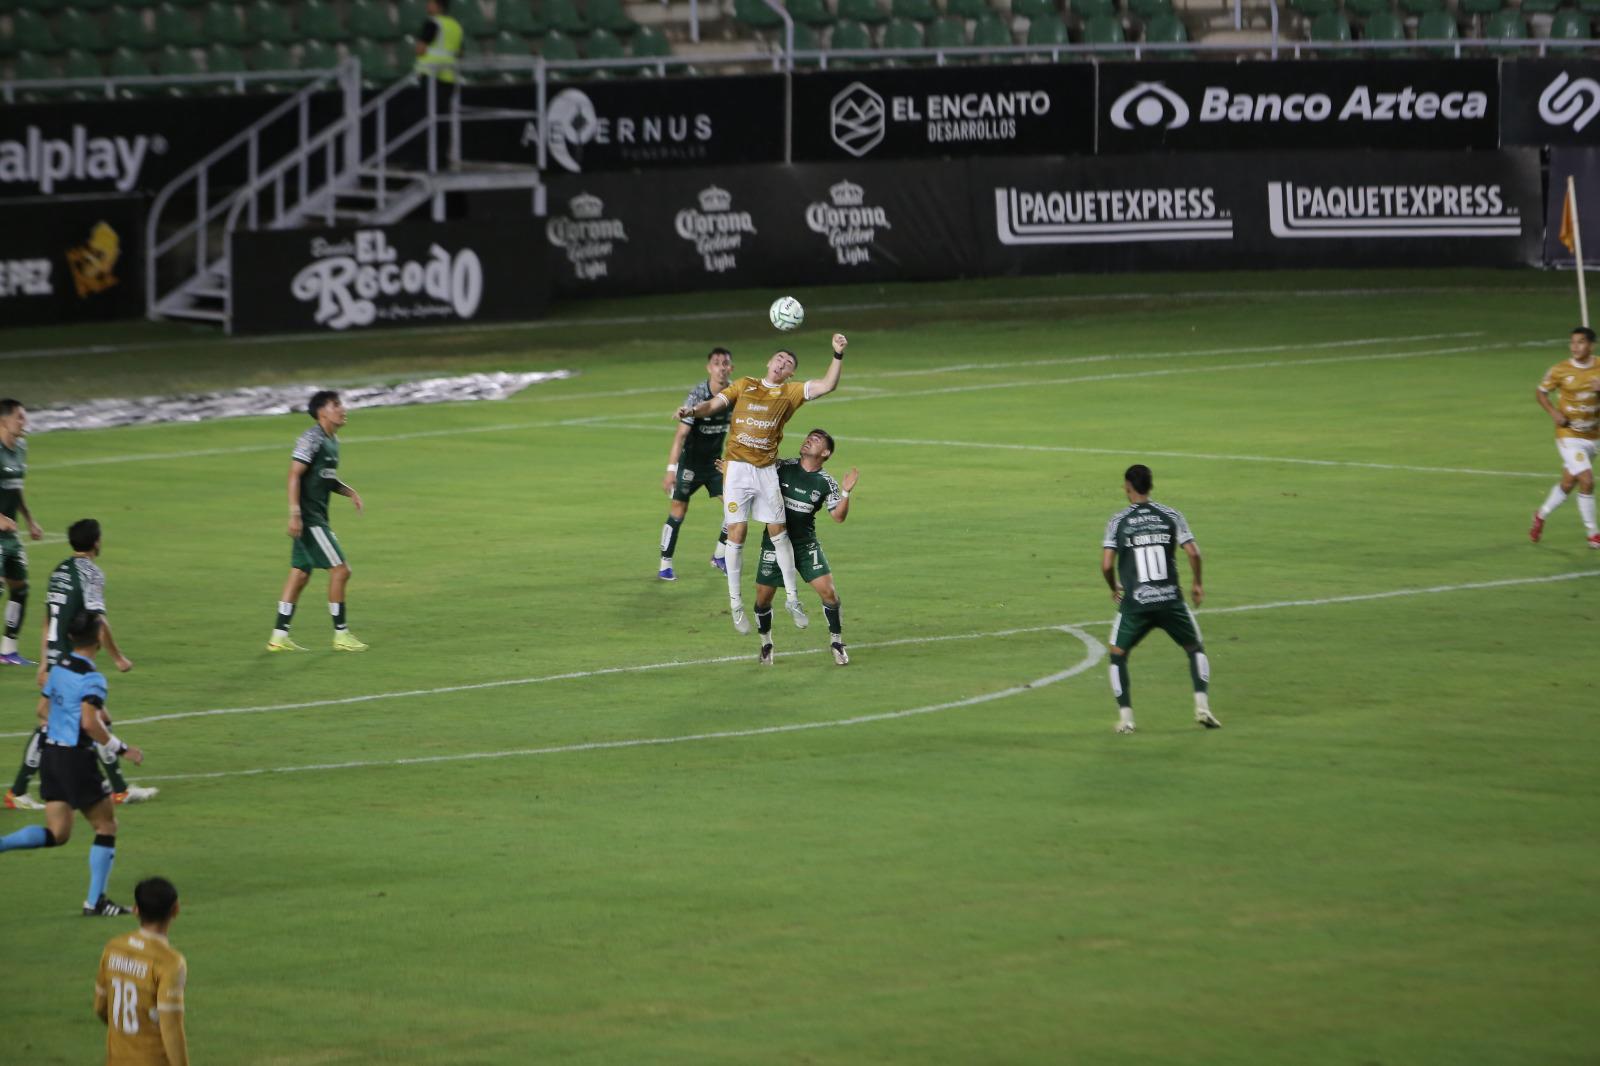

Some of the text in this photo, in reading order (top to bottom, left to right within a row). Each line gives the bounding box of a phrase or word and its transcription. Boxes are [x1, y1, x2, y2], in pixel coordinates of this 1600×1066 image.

[892, 90, 1051, 122] EL ENCANTO
[1200, 85, 1488, 122] Banco Azteca
[927, 118, 1017, 142] DESARROLLOS
[1020, 187, 1216, 224] PAQUETEXPRESS
[1296, 184, 1503, 219] PAQUETEXPRESS
[546, 217, 629, 248] Corona
[675, 208, 757, 240] Corona
[805, 202, 891, 234] Corona
[355, 229, 399, 263] EL
[836, 246, 870, 266] Light
[704, 252, 736, 273] Light
[809, 549, 820, 566] 7
[1133, 544, 1168, 583] 10
[111, 976, 139, 1035] 18
